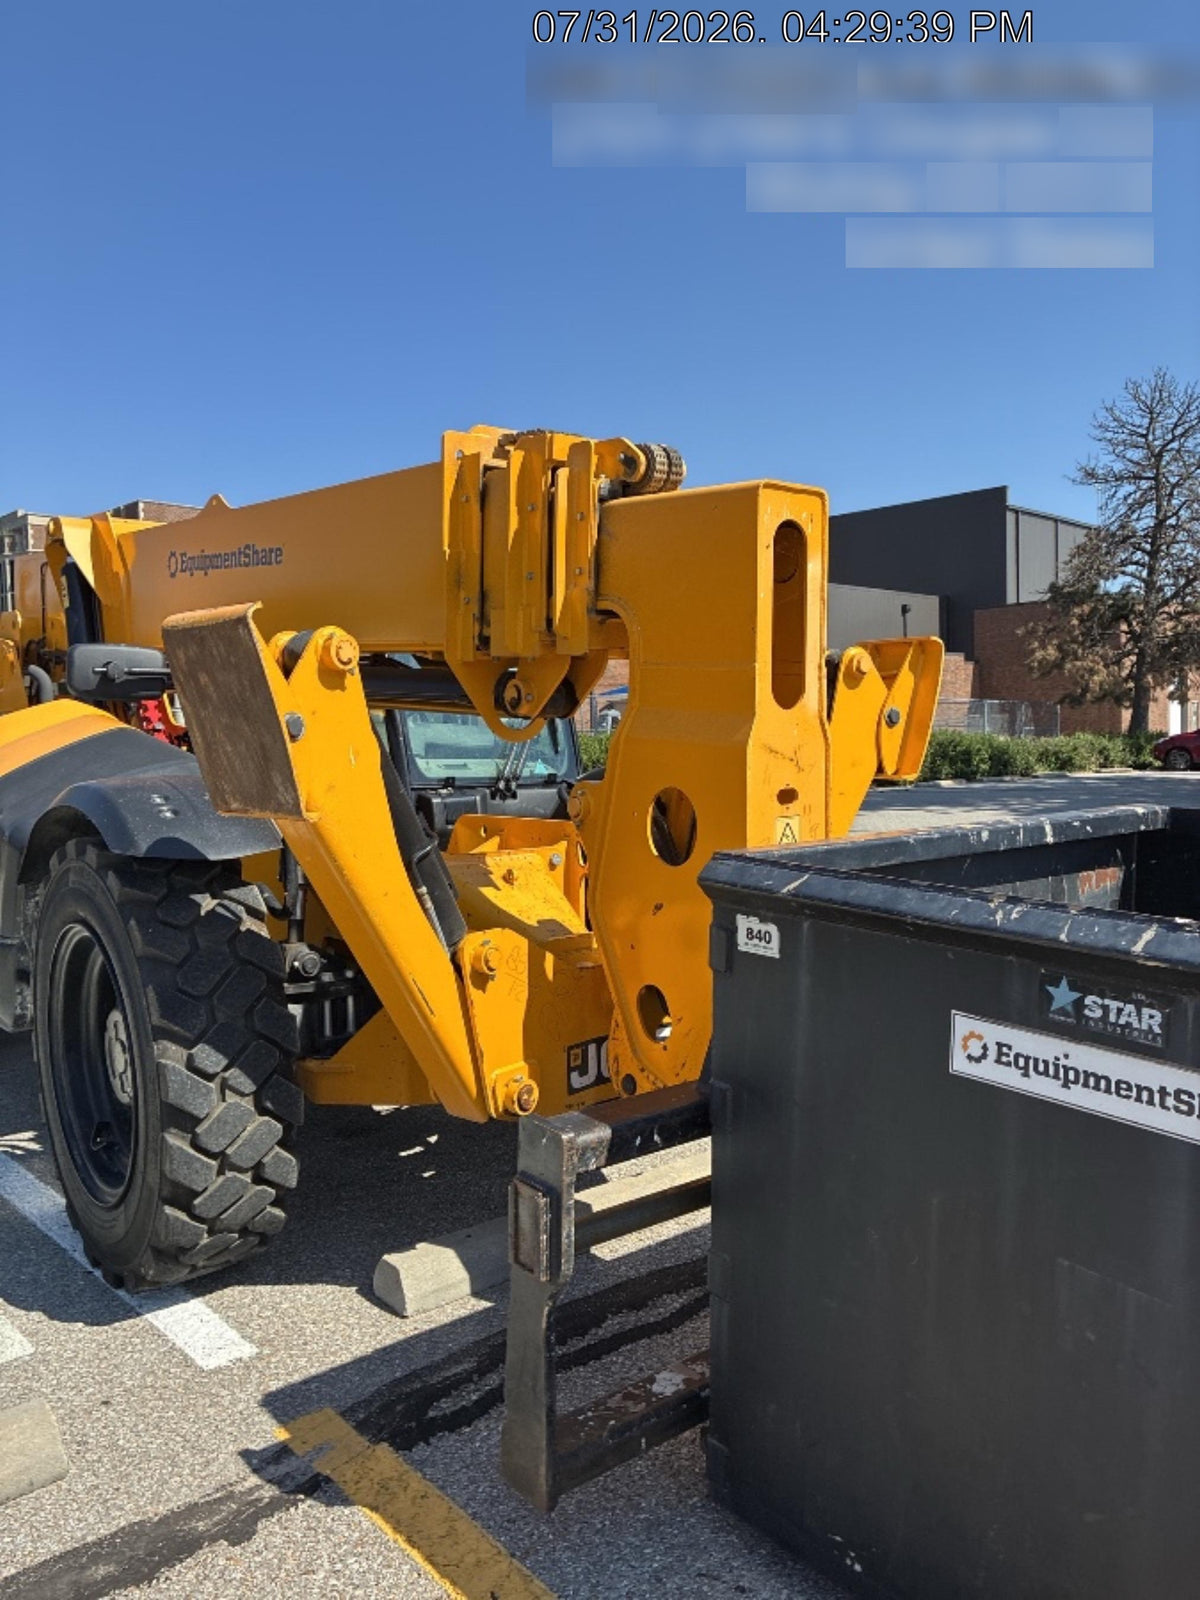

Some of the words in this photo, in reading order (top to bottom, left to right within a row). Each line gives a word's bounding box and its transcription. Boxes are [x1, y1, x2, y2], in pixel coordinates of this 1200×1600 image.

[179, 543, 283, 577] EquipmentShare
[746, 927, 772, 945] 840
[1083, 994, 1162, 1034] STAR
[994, 1041, 1200, 1120] EquipmentS
